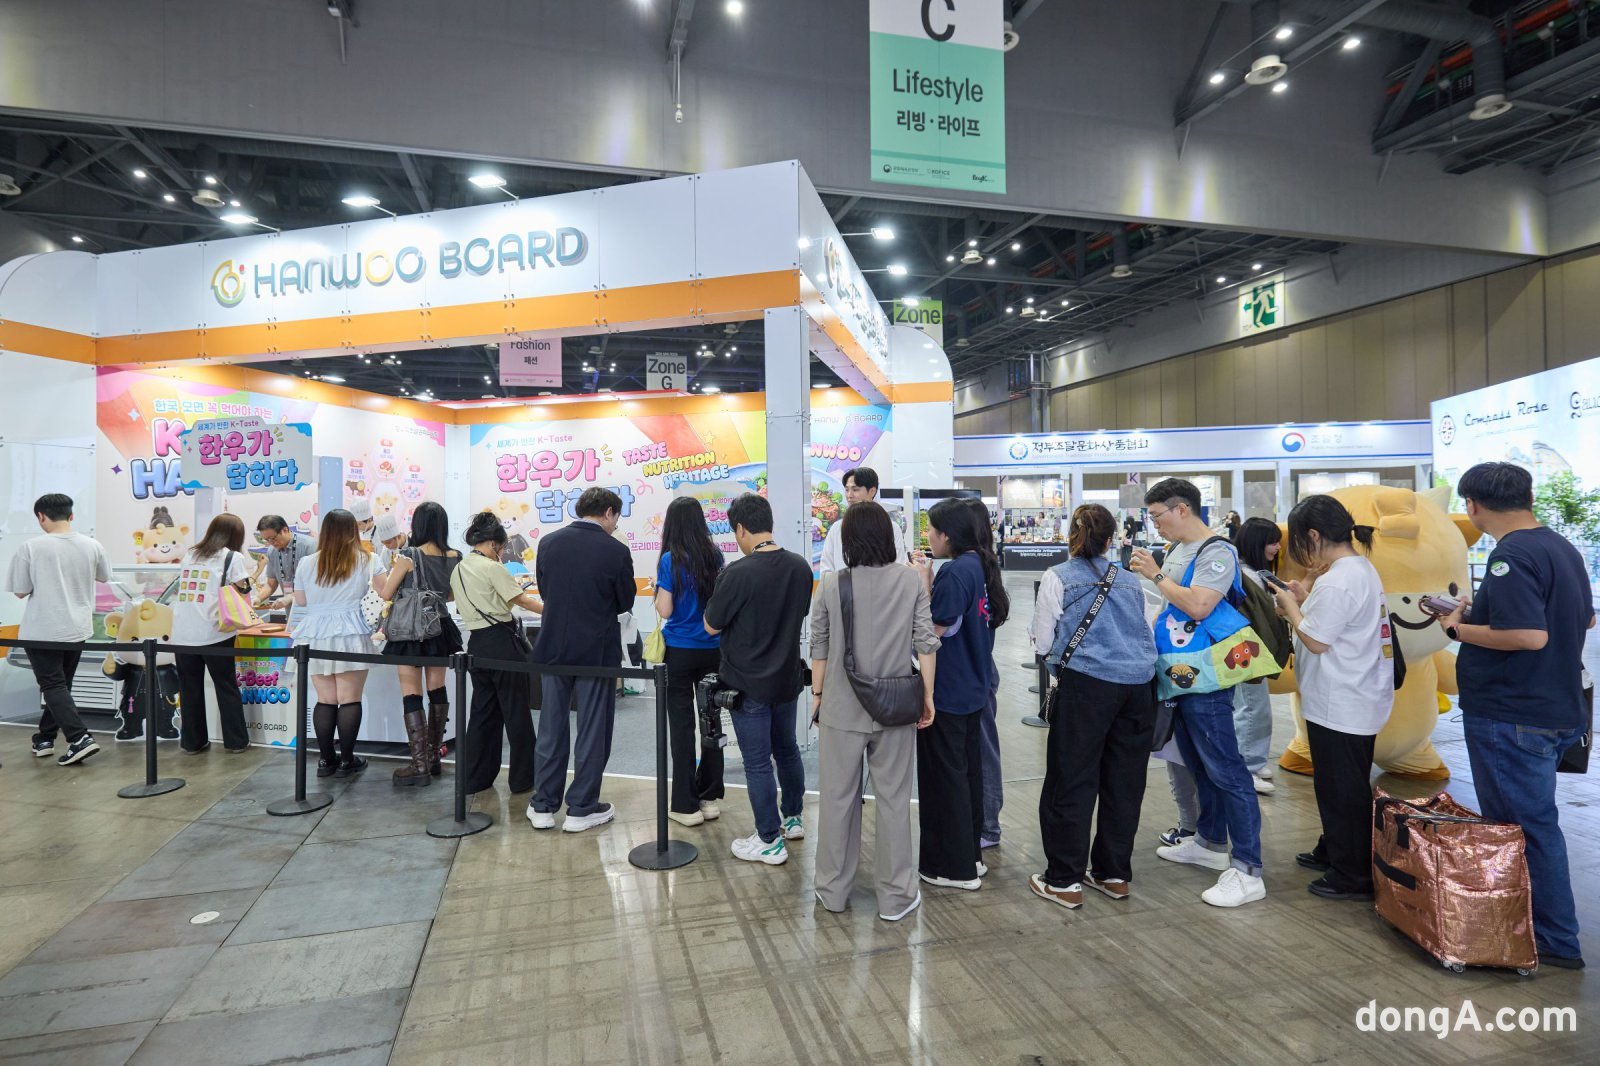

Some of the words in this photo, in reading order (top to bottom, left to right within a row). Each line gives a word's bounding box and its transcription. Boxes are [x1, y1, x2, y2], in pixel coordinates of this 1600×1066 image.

[921, 0, 956, 42] C
[892, 68, 984, 105] Lifestyle
[252, 246, 427, 297] HANWOO
[438, 226, 589, 279] BOARD
[895, 303, 941, 324] Zone
[648, 358, 686, 375] Zone
[661, 376, 673, 390] G
[154, 399, 179, 413] 한국
[182, 399, 205, 414] 오면
[207, 401, 218, 415] 꼭
[221, 402, 251, 417] 먹어야
[854, 414, 883, 422] BOARD
[1464, 411, 1512, 427] Compass
[1516, 401, 1550, 416] Rose
[230, 420, 259, 428] K-Taste
[198, 430, 273, 466] 한우가
[537, 434, 573, 445] K-Taste
[622, 441, 668, 466] TASTE
[810, 442, 862, 462] NWOO
[226, 459, 299, 491] 답하다
[495, 448, 601, 493] 한우가
[642, 451, 717, 477] NUTRITION
[662, 464, 730, 489] HERITAGE
[1105, 566, 1118, 584] GUESS
[1089, 594, 1105, 616] GUESS
[1068, 627, 1086, 649] GUESS
[241, 686, 291, 705] NWOO
[264, 724, 288, 732] BOARD
